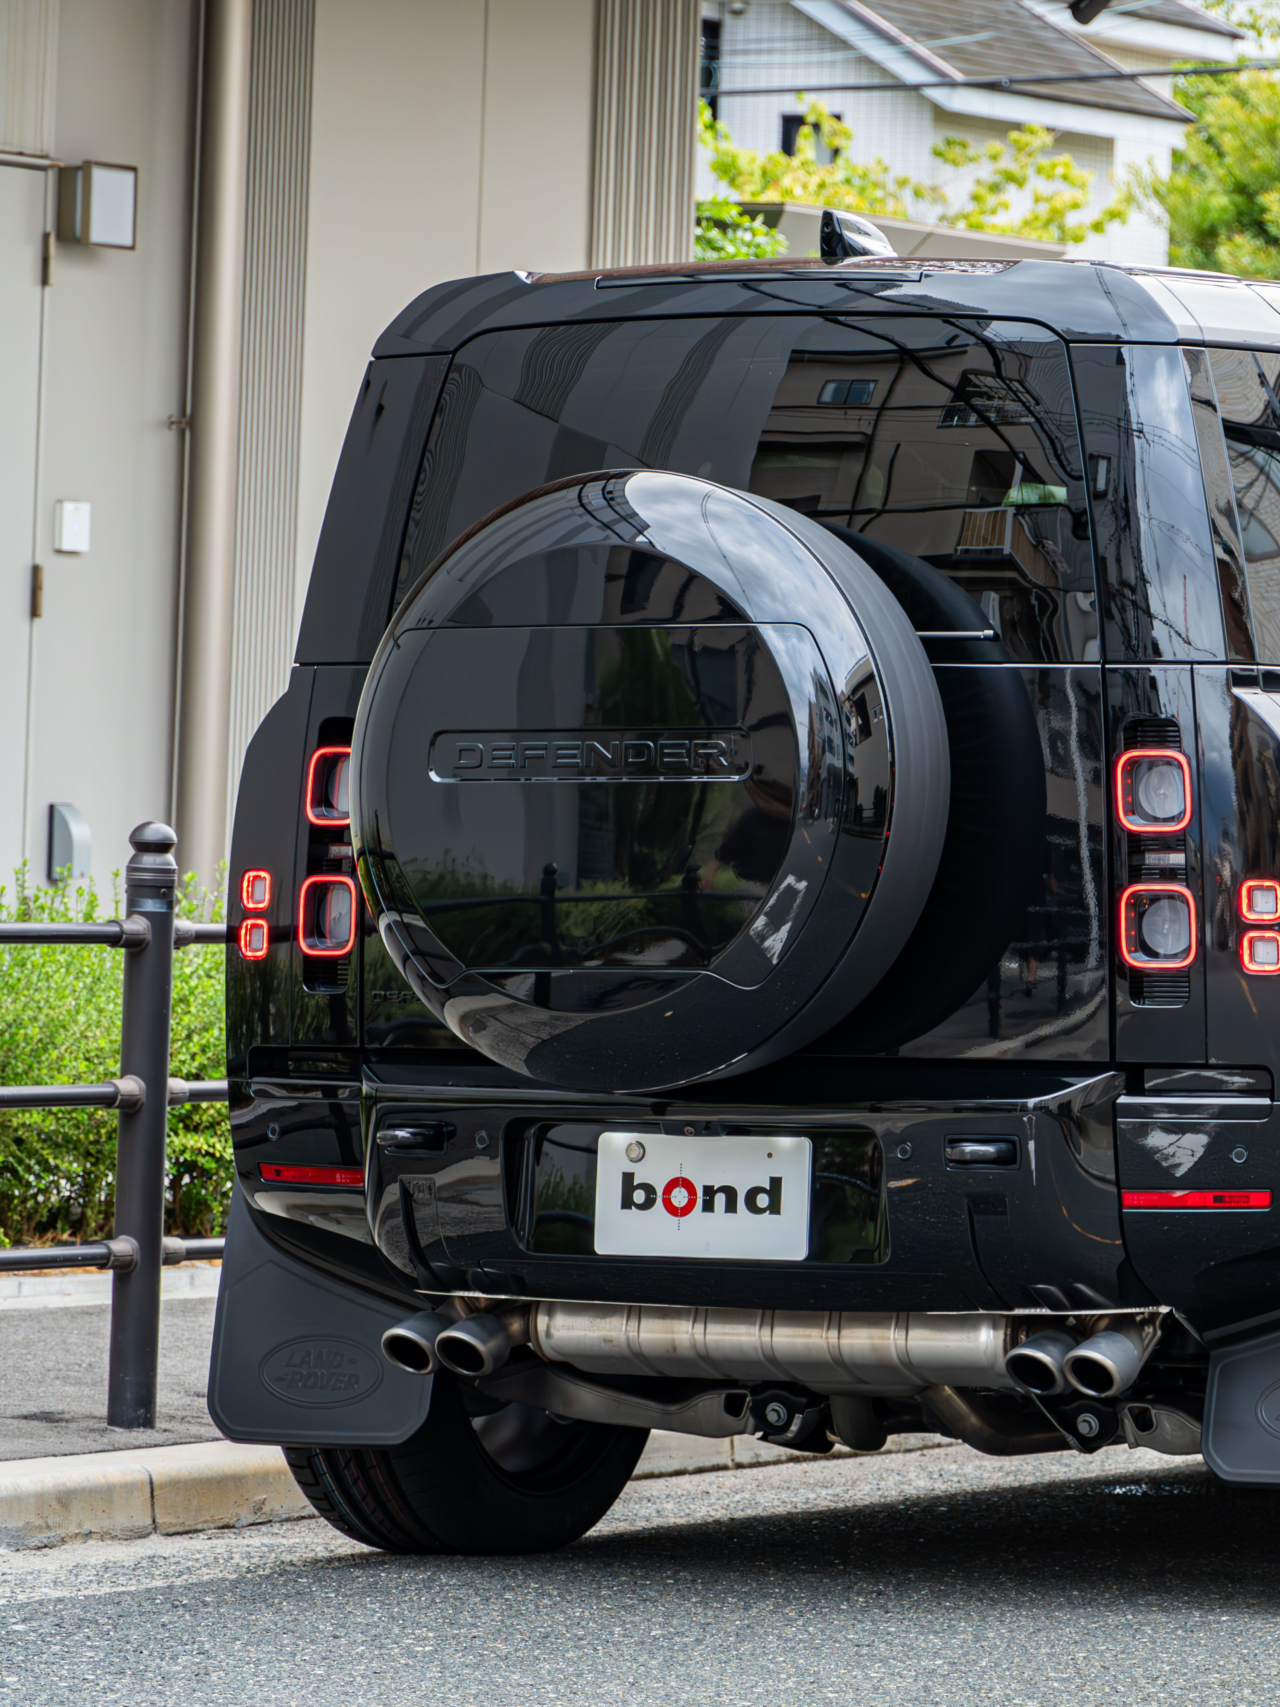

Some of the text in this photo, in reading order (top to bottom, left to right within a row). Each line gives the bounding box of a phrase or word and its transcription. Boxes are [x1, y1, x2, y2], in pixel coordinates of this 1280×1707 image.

[453, 740, 729, 769] DEFENDER
[620, 1171, 783, 1218] bond
[285, 1348, 344, 1368] LAND
[287, 1370, 361, 1391] ROVER
